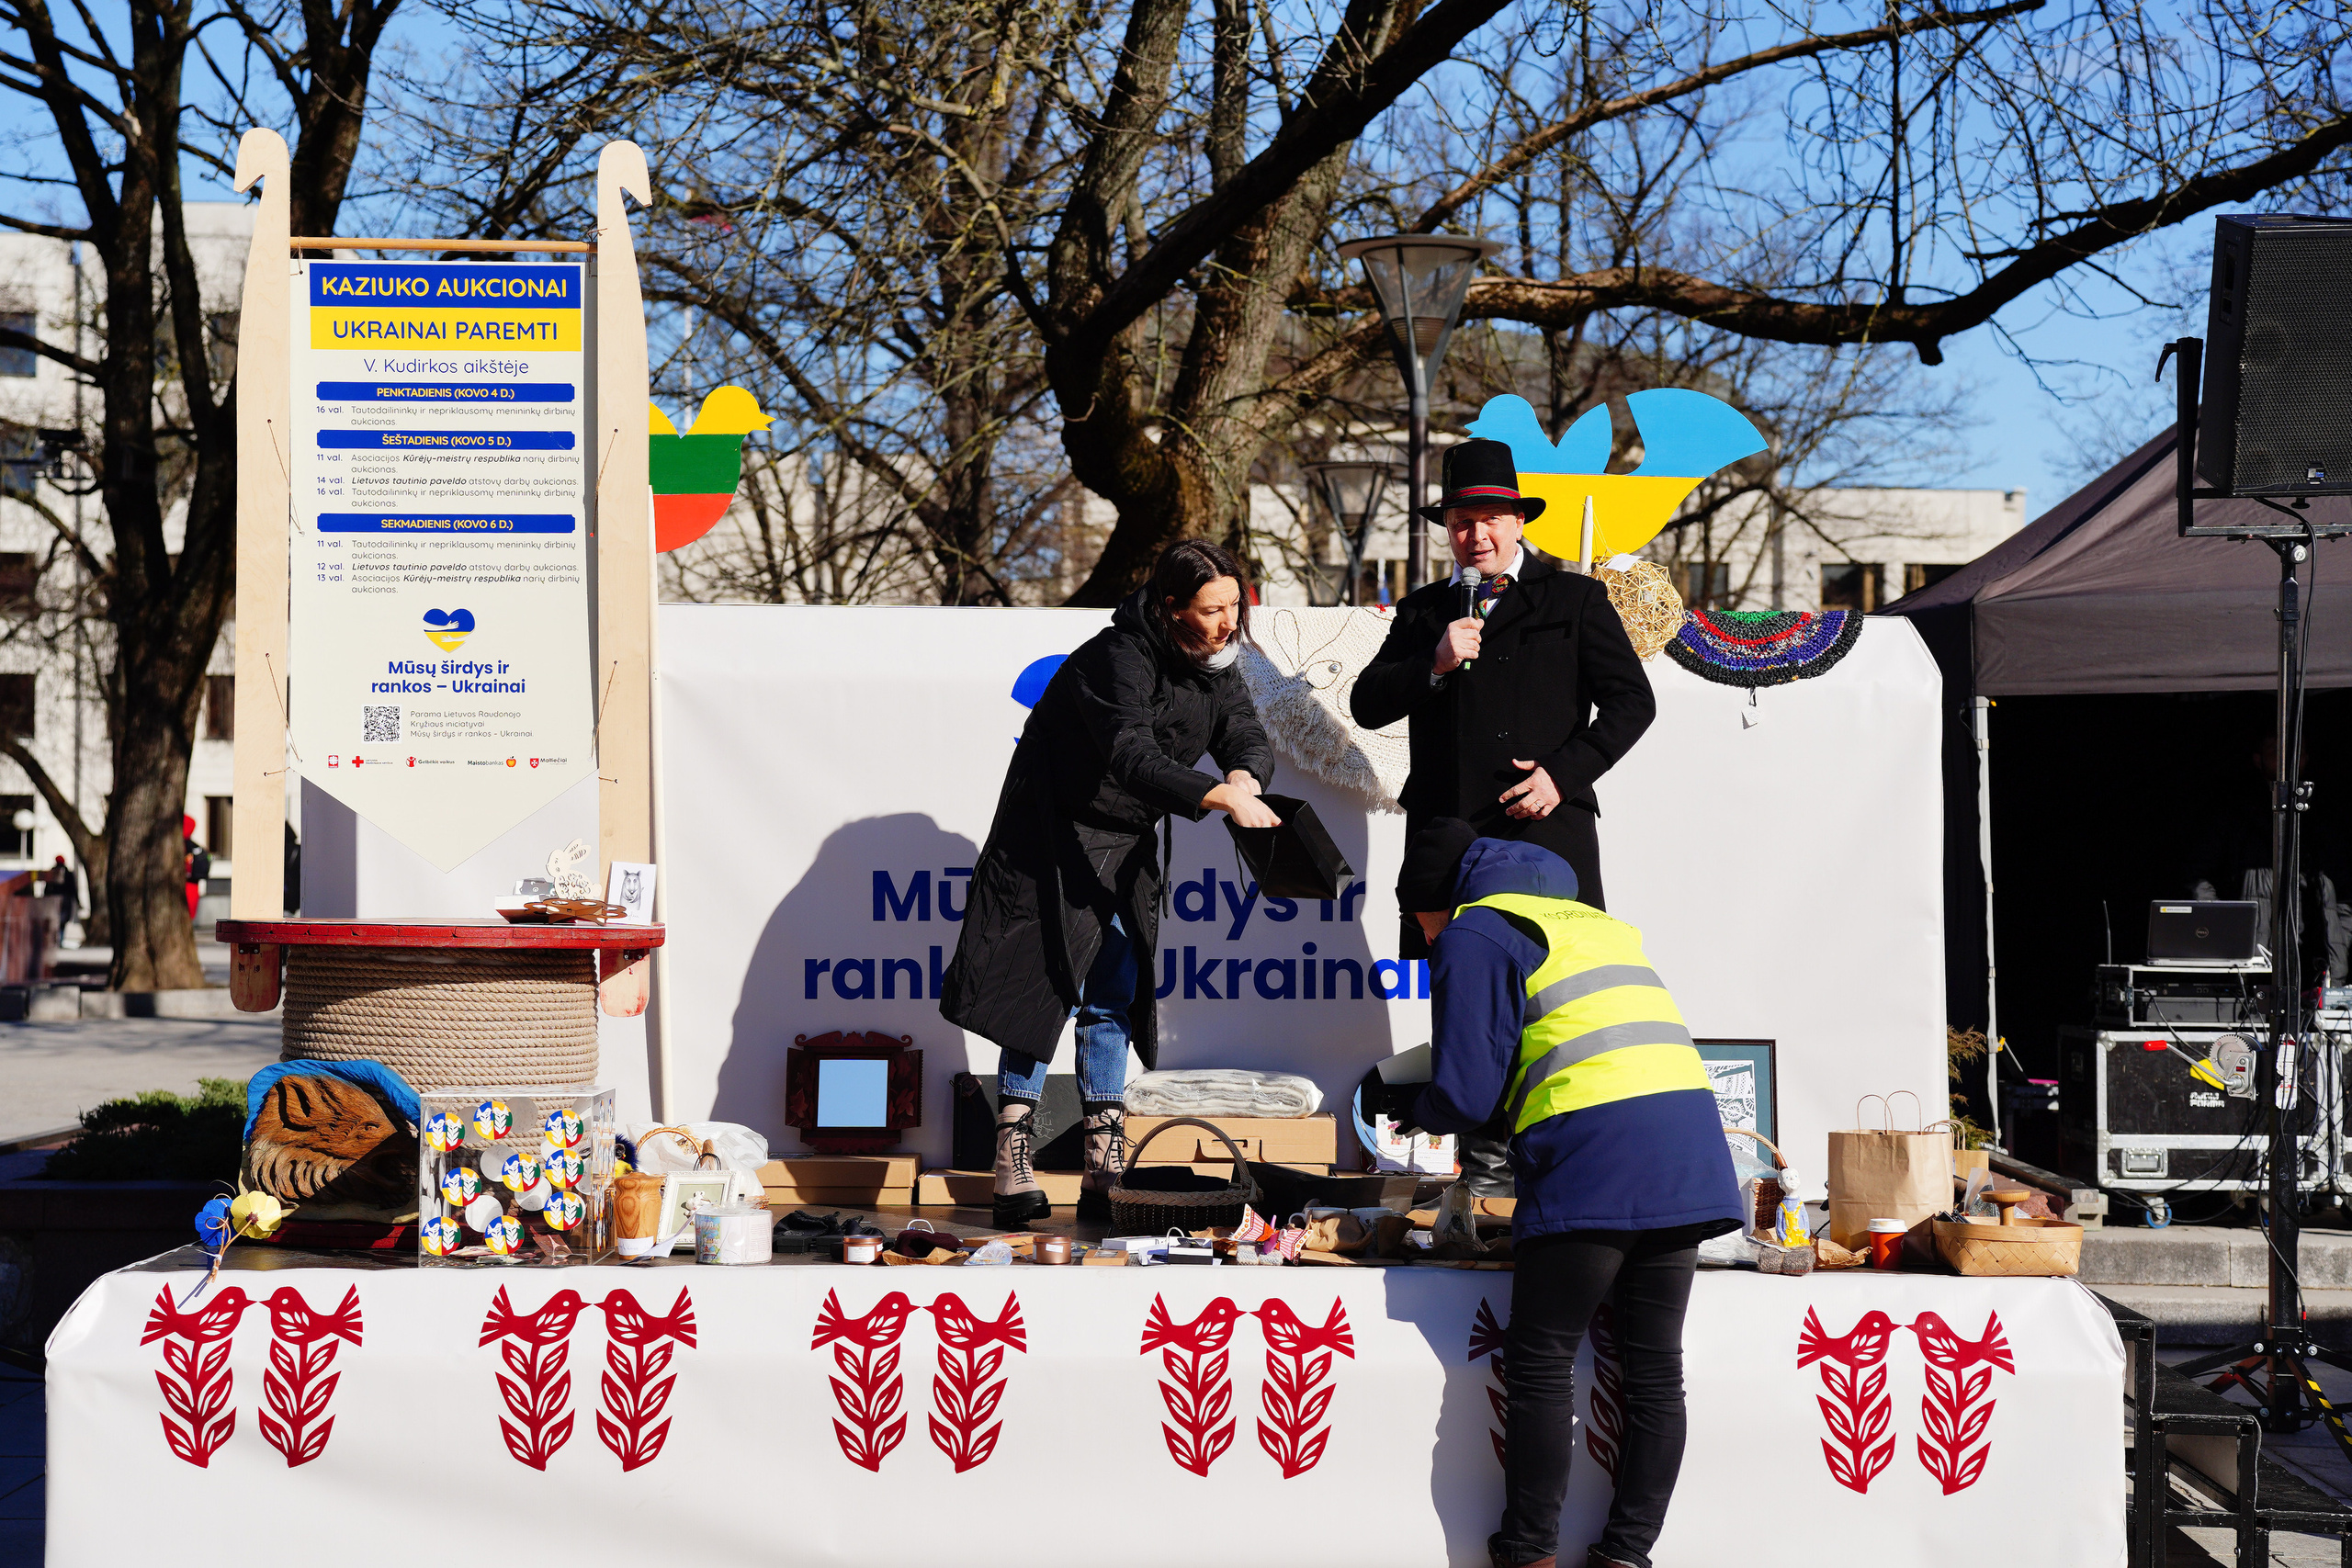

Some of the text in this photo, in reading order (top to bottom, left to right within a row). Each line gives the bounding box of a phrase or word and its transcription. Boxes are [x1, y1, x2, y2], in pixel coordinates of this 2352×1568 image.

[322, 276, 566, 298] KAZIUKO AUKCIONAI
[334, 320, 557, 340] UKRAINAI PAREMTI
[364, 359, 528, 377] V. Kudirkos aikštėje
[377, 388, 514, 400] PENKTADIENIS (KOVO 4 D.)
[316, 405, 326, 413] 16
[327, 405, 345, 413] val.
[352, 406, 417, 415] Tautodailininkų
[429, 407, 493, 416] nepriklausomų
[496, 408, 540, 416] menininkų
[544, 408, 575, 416] dirbinių
[350, 417, 399, 425] aukcionas.
[382, 434, 512, 447] ŠEŠTADIENIS (KOVO 5 D.)
[352, 455, 400, 463] Asociacijos
[403, 455, 471, 464] Kūrėjų-meistrų
[473, 455, 521, 463] respublika
[523, 456, 545, 464] narių
[548, 456, 579, 464] dirbinių
[350, 465, 399, 473] aukcionas.
[328, 476, 345, 484] val.
[351, 476, 390, 484] Lietuvos
[430, 478, 467, 486] paveldo
[469, 479, 501, 487] atstovų
[504, 478, 530, 487] darbų
[316, 487, 326, 495] 16
[352, 488, 417, 498] Tautodailininkų
[430, 489, 493, 498] nepriklausomų
[497, 490, 541, 498] menininkų
[544, 490, 575, 498] dirbinių
[351, 499, 399, 507] aukcionas.
[381, 519, 514, 530] SEKMADIENIS (KOVO 6 D.)
[326, 539, 344, 547] val.
[352, 540, 417, 549] Tautodailininkų
[430, 541, 493, 549] nepriklausomų
[497, 541, 541, 549] menininkų
[544, 541, 575, 550] dirbinių
[351, 551, 399, 559] aukcionas.
[351, 562, 390, 570] Lietuvos
[392, 562, 428, 570] tautinio
[429, 563, 468, 571] paveldo
[468, 564, 502, 572] atstovų
[504, 564, 530, 572] darbų
[532, 563, 579, 571] aukcionas.
[317, 573, 580, 584] 13 val. Asociacijos Kūrėjų-meistrų respublika narių dirbinių
[351, 585, 399, 593] aukcionas.
[389, 660, 509, 679] Mūsų širdys ir
[372, 680, 431, 693] rankos
[453, 679, 525, 693] Ukrainai
[478, 710, 522, 718] Raudonojo
[410, 720, 444, 728] Kryžiaus
[411, 730, 430, 739] Mūsų
[433, 730, 456, 739] širdys
[872, 867, 973, 921] Mū
